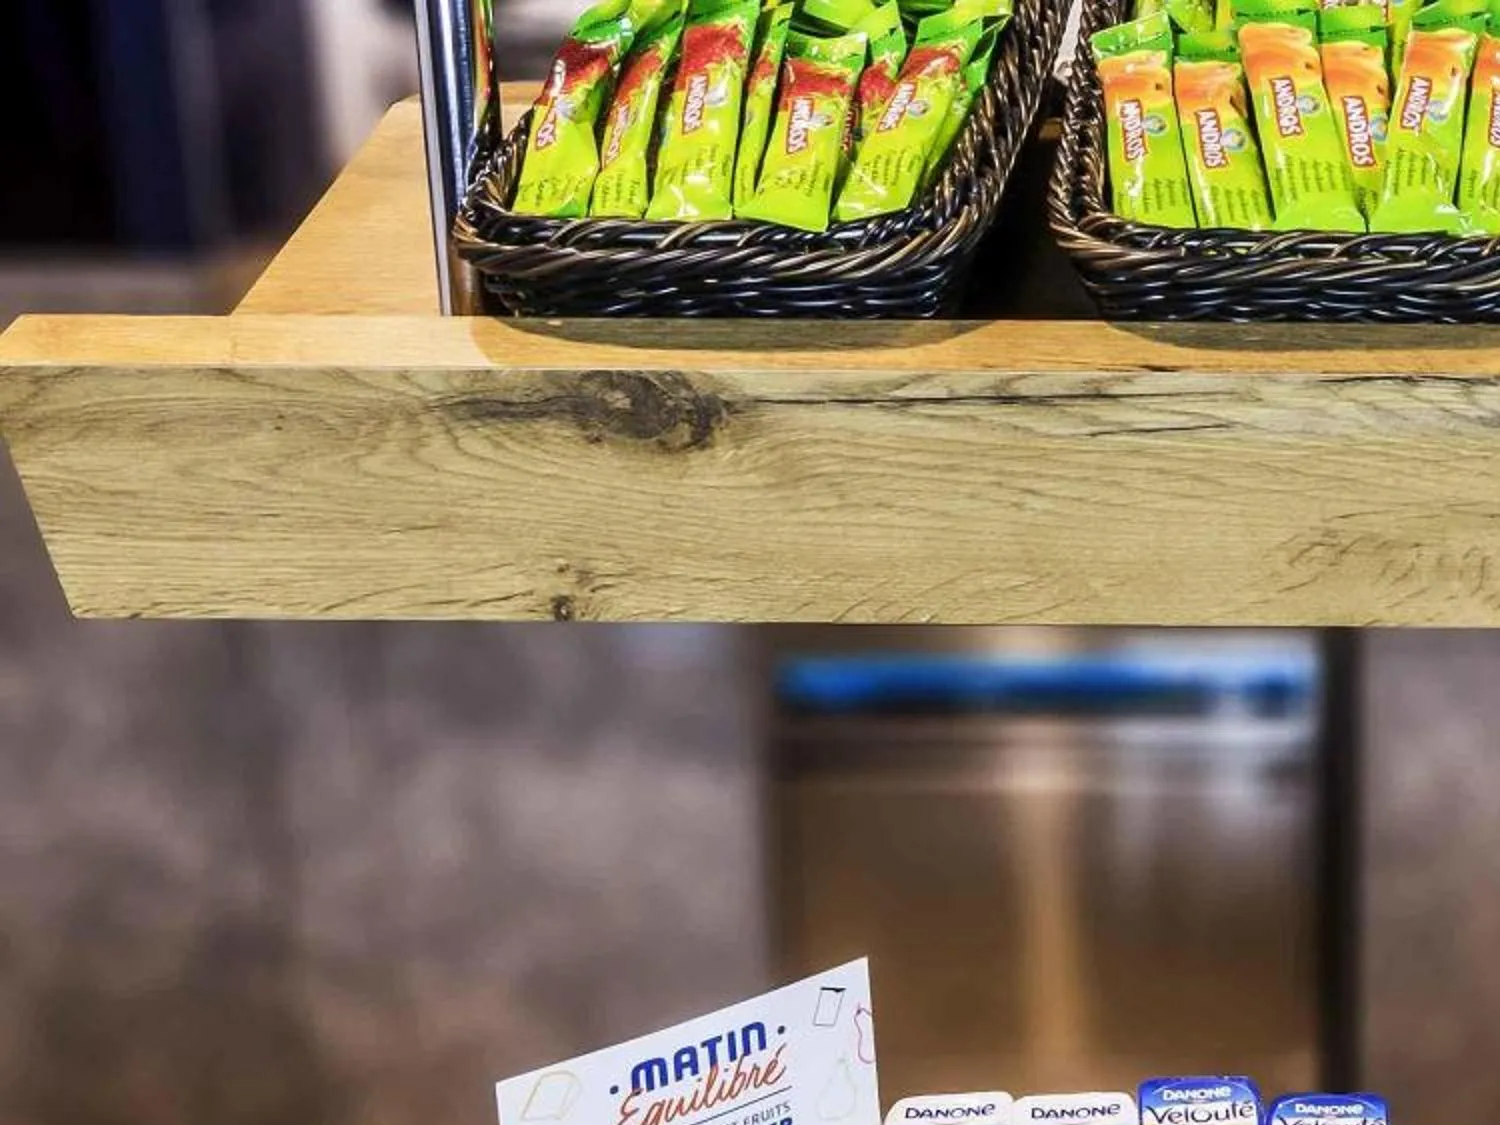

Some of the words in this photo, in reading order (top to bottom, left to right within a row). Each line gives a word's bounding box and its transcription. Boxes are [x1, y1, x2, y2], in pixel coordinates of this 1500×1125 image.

[1199, 110, 1226, 167] ANDROS
[1345, 97, 1374, 165] ANDROS
[631, 1021, 767, 1094] MATIN
